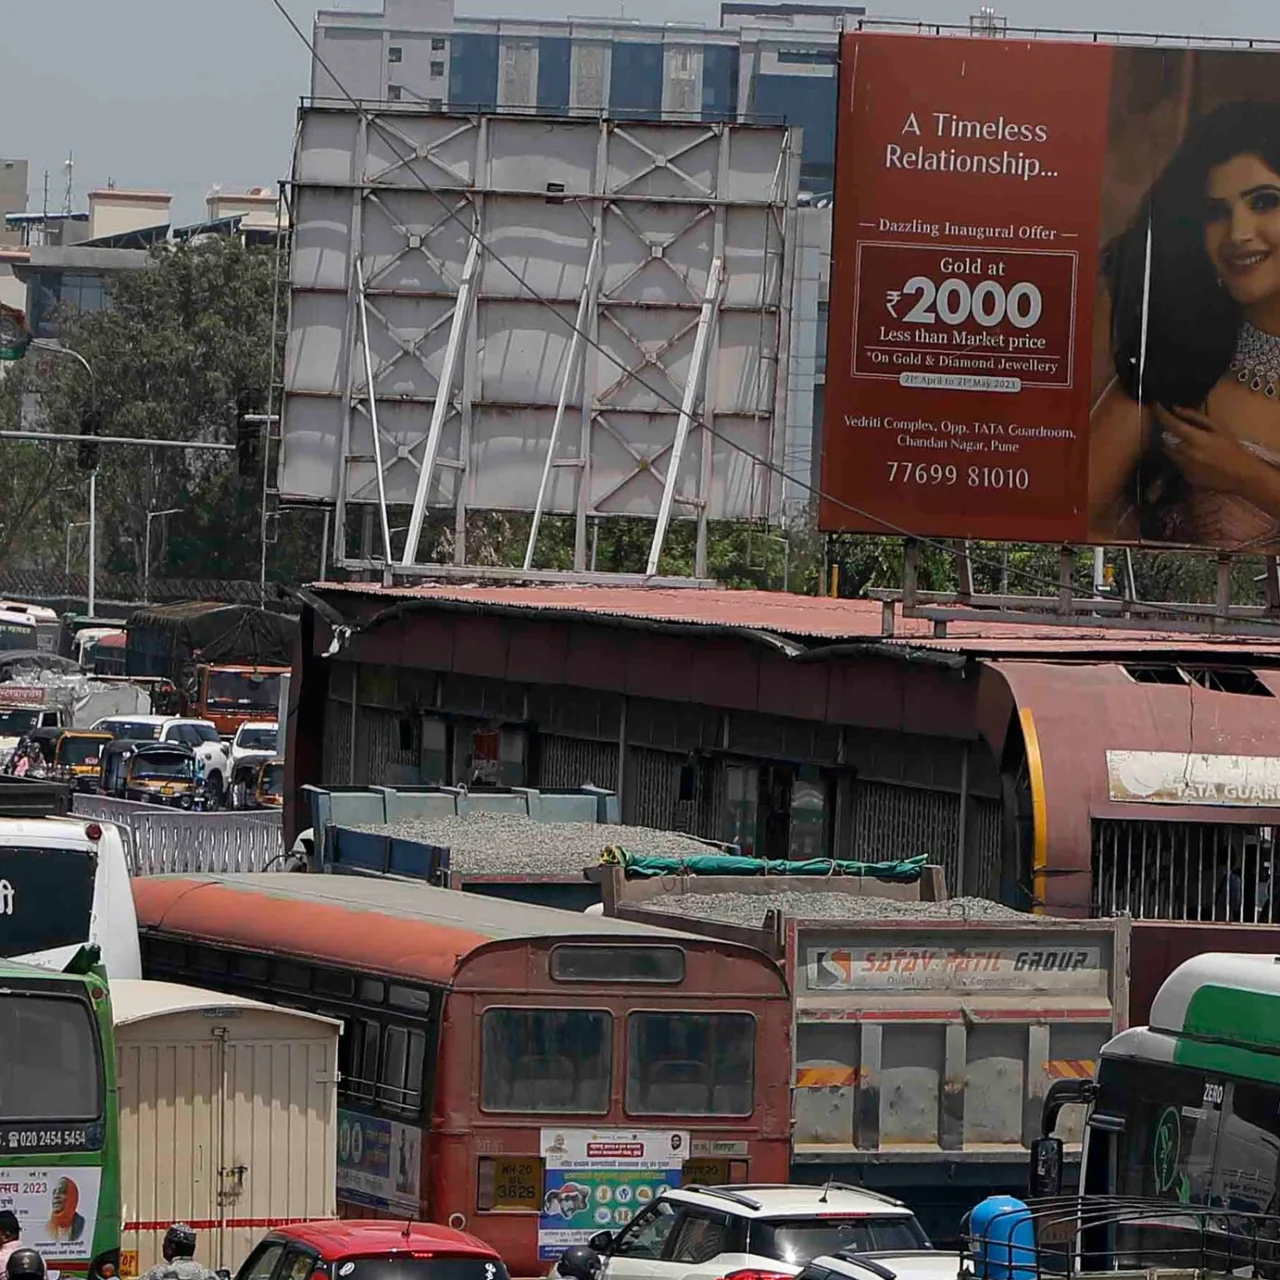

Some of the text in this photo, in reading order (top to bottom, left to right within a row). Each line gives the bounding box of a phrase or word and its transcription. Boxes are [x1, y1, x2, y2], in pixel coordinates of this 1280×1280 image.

[901, 112, 1048, 142] A Timeless
[885, 144, 1058, 181] Relationship...
[878, 218, 1057, 240] Dazzling Inaugural Offer
[939, 257, 1006, 276] Gold at
[878, 326, 1047, 351] Less than Market price
[893, 352, 922, 366] Gold
[925, 355, 936, 366] &
[938, 356, 994, 369] Diamond
[998, 358, 1059, 374] Jewellery
[922, 375, 942, 387] April
[944, 377, 955, 386] to
[973, 378, 992, 389] May
[993, 379, 1017, 390] 2023
[843, 414, 1077, 439] Vedriti Complex, Opp. TATA Guardroom,
[896, 434, 1019, 453] Chandan Nagar, Pune
[886, 461, 1029, 490] 77699 81010
[1174, 782, 1218, 799] TATA
[1013, 951, 1089, 972] GROUP
[1203, 1083, 1224, 1104] ZERO
[20, 1131, 86, 1146] 020 2454 5454
[23, 1182, 48, 1194] 2023
